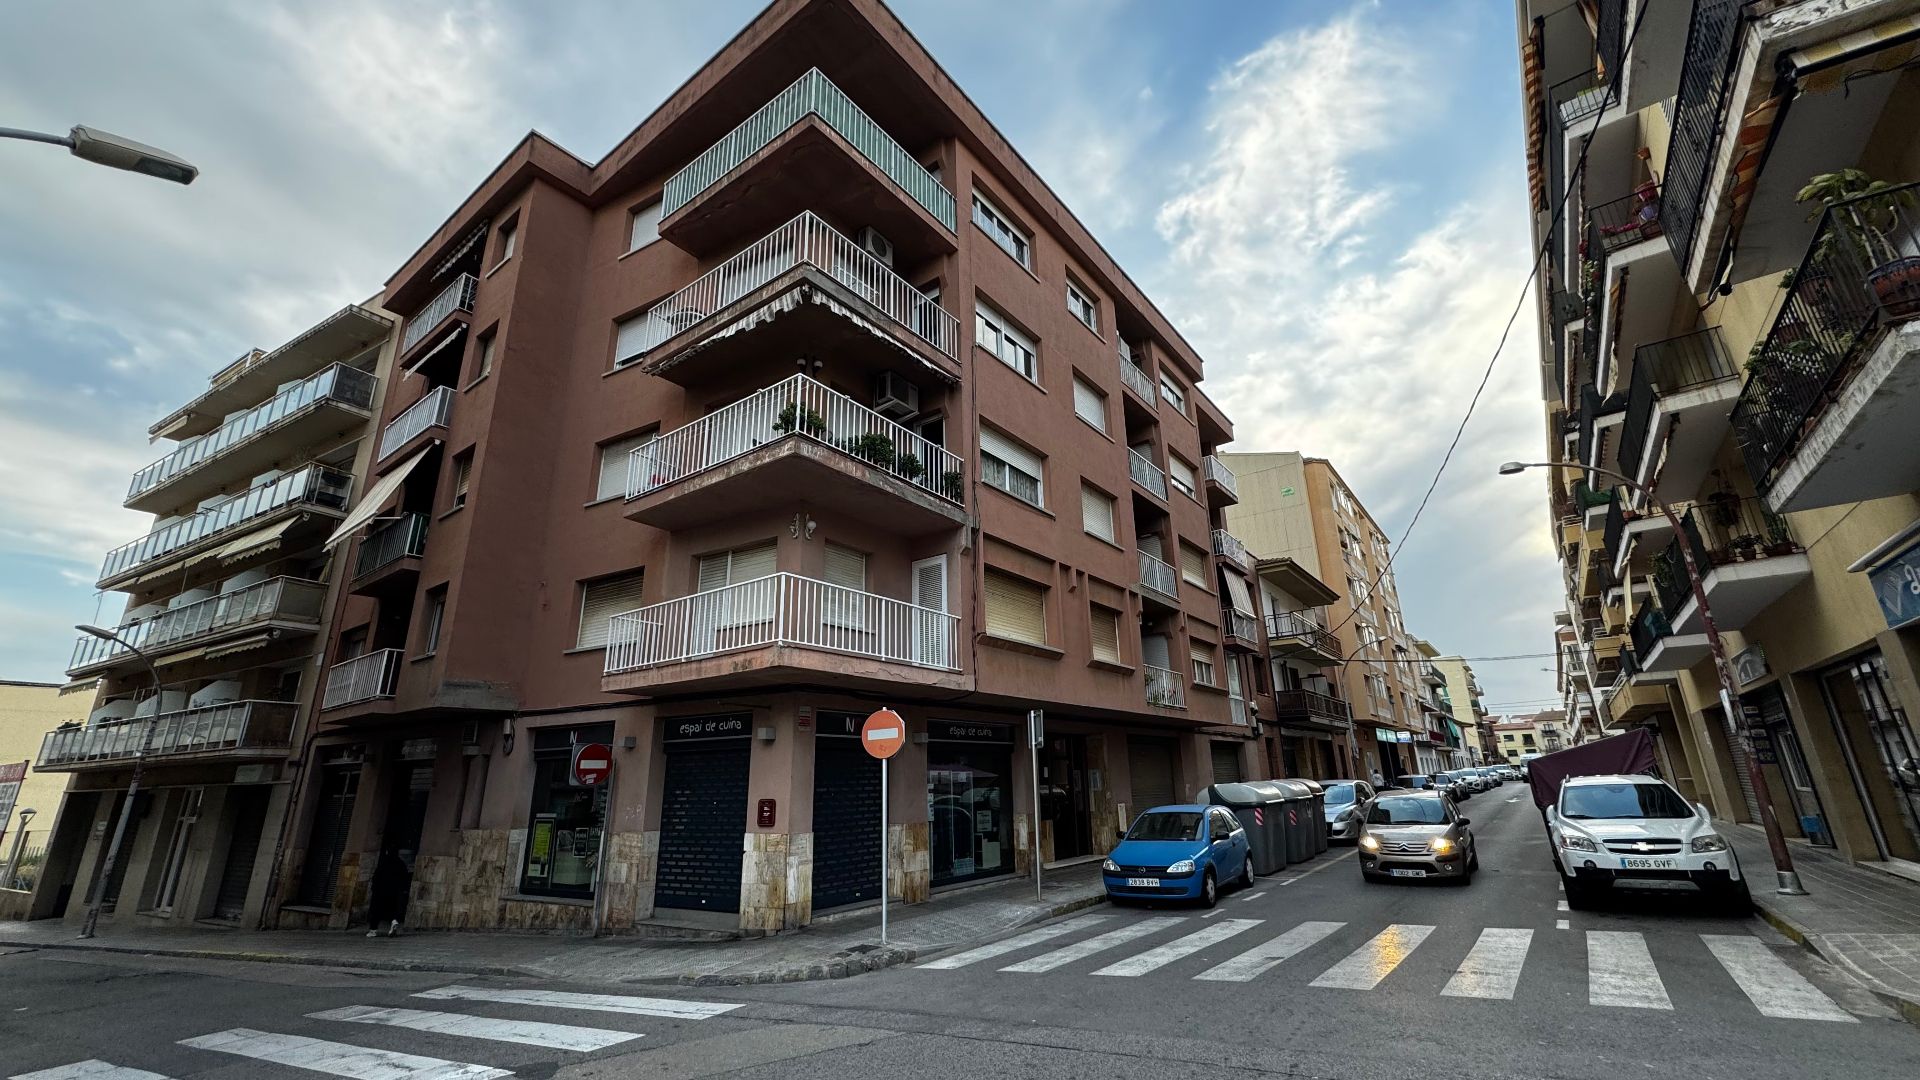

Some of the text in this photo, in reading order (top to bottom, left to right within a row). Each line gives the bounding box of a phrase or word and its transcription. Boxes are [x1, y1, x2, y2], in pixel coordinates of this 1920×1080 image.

[679, 718, 741, 736] espai de cuina
[949, 726, 966, 737] espai
[1627, 859, 1673, 868] 8695 GVF
